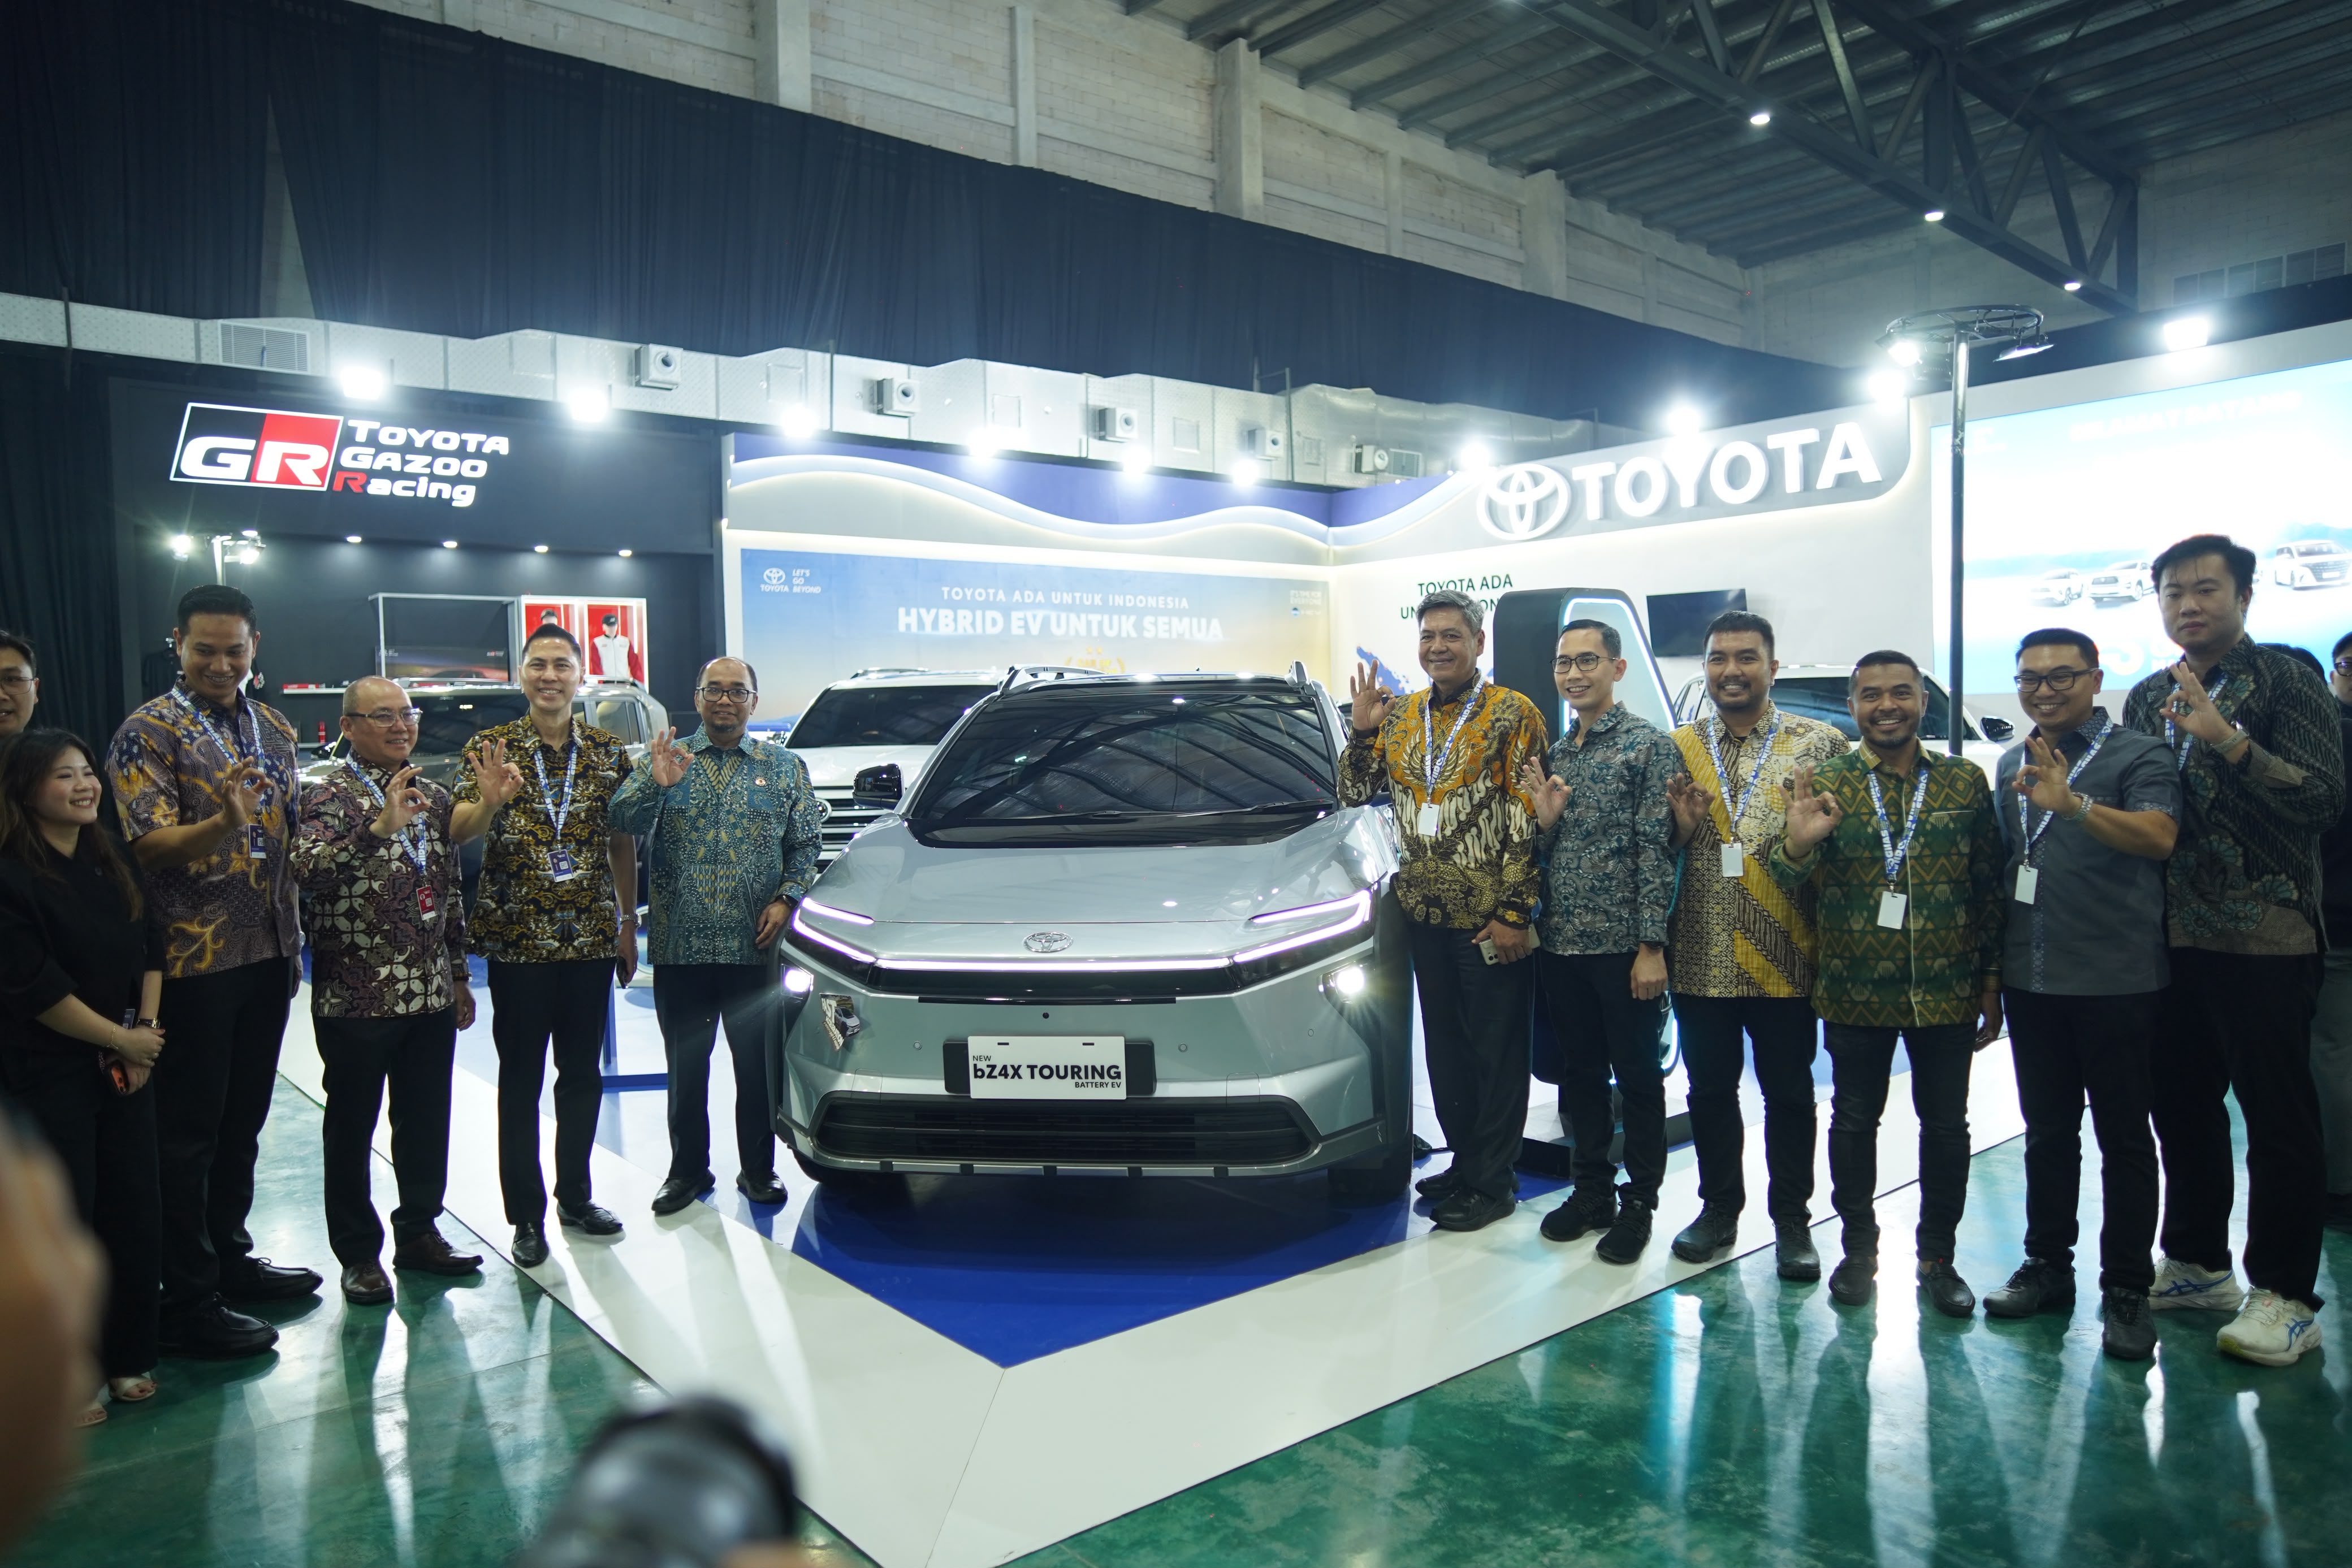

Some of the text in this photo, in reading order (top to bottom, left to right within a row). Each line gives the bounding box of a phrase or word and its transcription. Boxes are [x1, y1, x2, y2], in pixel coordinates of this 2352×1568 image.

[347, 419, 509, 455] TOYOTA
[180, 436, 330, 486] GR
[340, 447, 487, 478] GAZOO
[1572, 422, 1883, 521] TOYOTA
[332, 471, 476, 507] Racing
[760, 584, 789, 592] TOYOTA
[941, 587, 1189, 609] TOYOTA ADA UNTUK INDONESIA
[1418, 574, 1513, 596] TOYOTA ADA
[898, 607, 1223, 639] HYBRID EV UNTUK SEMUA
[1916, 782, 1926, 808] GIIAS
[398, 833, 418, 859] GIIAS
[1880, 829, 1893, 858] GIIAS
[822, 998, 837, 1024] FAST
[973, 1064, 1121, 1080] bZ4X TOURING
